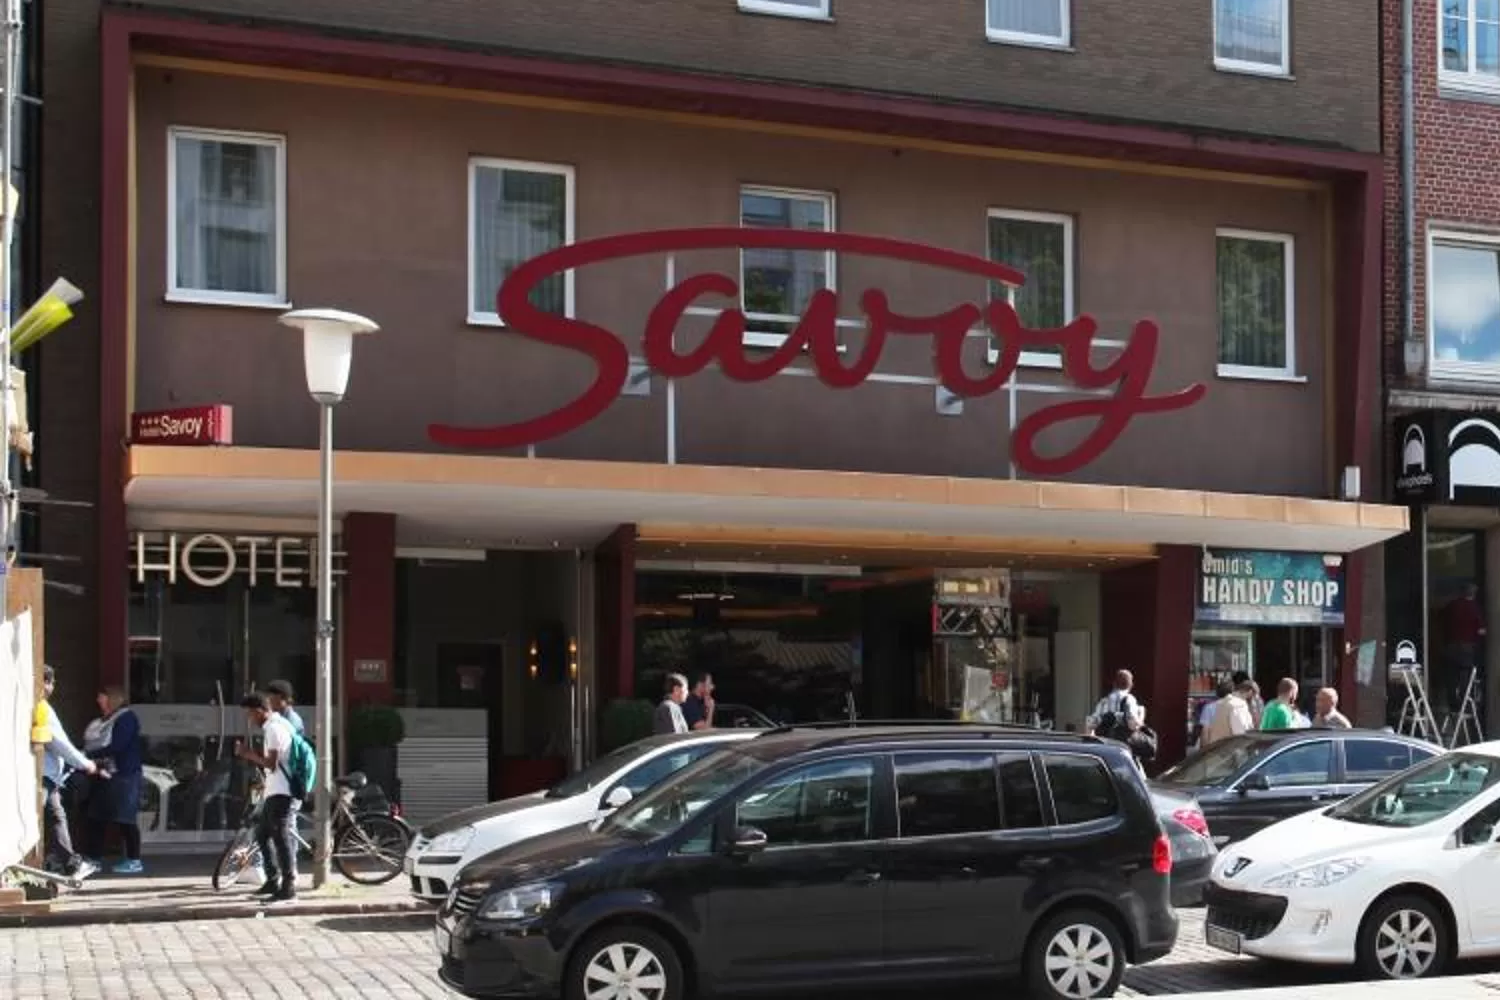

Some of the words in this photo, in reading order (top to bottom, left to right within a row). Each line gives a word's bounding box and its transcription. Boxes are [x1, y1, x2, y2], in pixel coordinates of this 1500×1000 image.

[427, 227, 1206, 475] Savoy
[160, 415, 203, 439] Savoy
[1203, 576, 1275, 604] HANDY
[1282, 579, 1339, 607] SHOP
